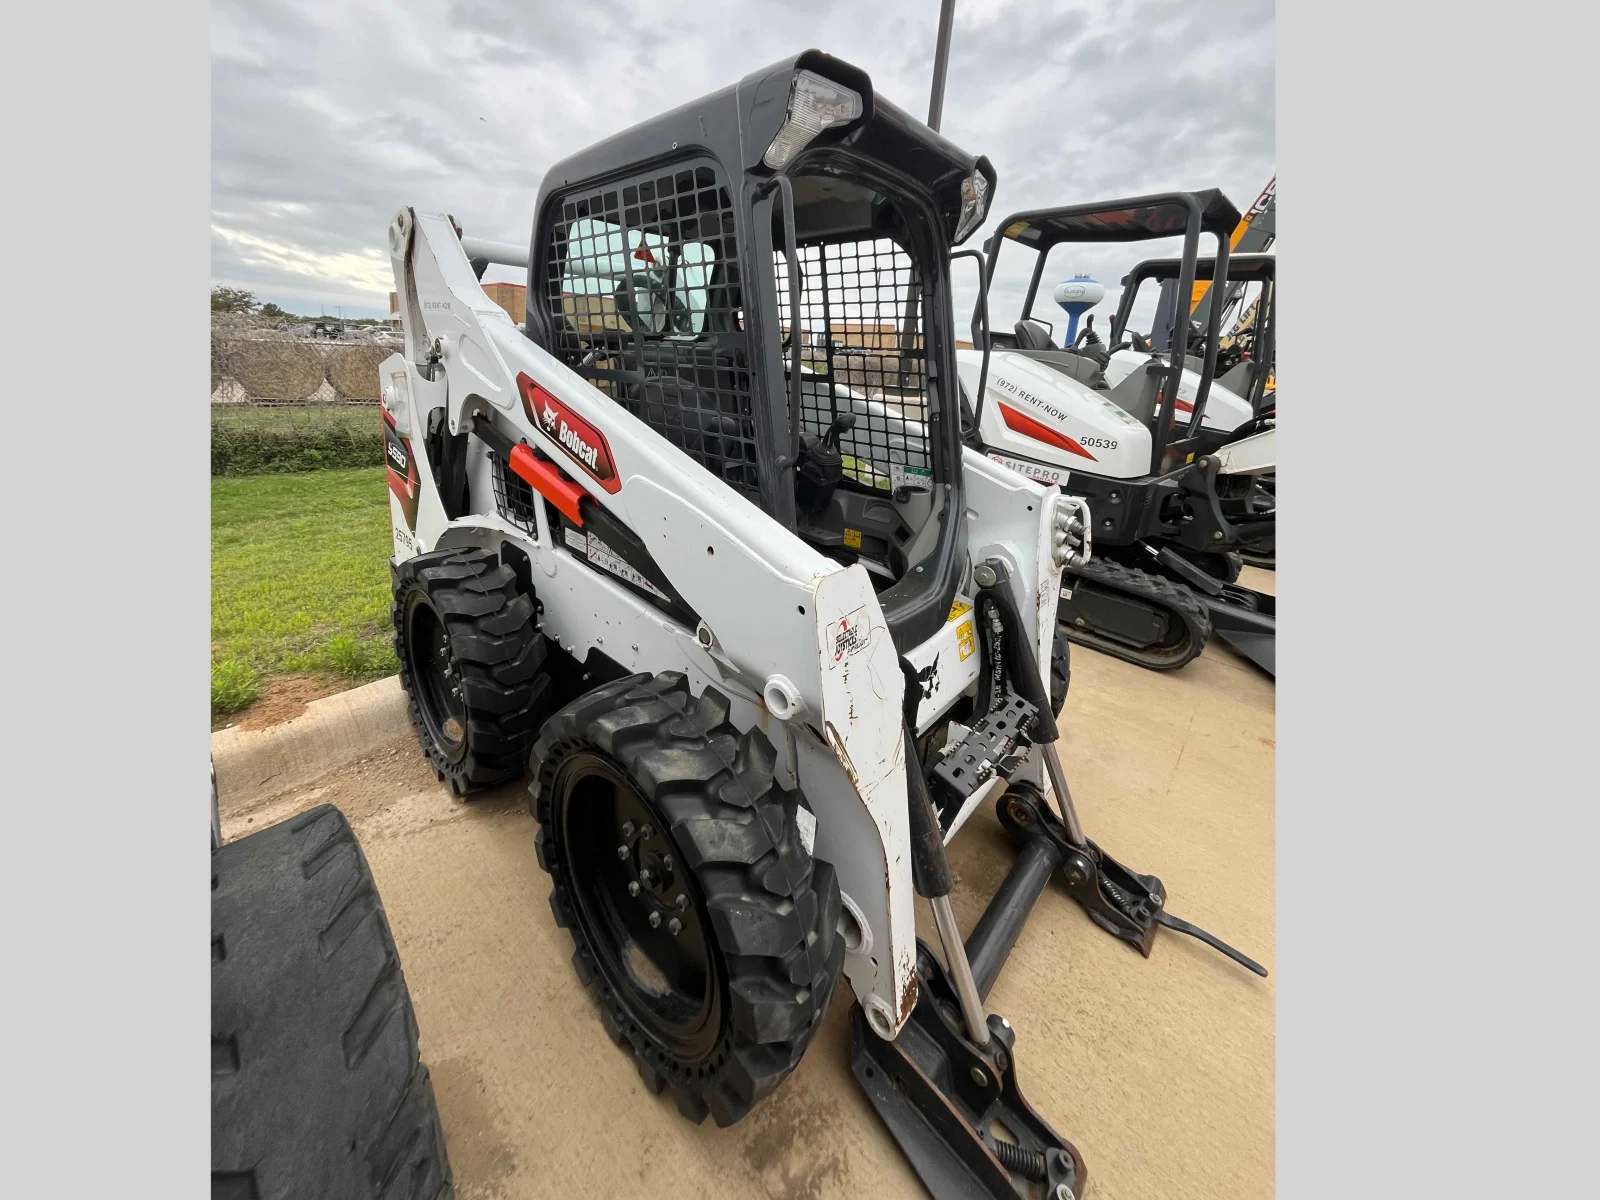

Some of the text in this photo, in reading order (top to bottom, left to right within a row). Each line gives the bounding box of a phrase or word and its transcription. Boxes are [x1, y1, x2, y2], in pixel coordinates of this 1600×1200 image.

[1226, 324, 1240, 341] JLG
[1239, 304, 1257, 324] LIFT
[996, 378, 1068, 421] (972) RENT-NOW
[387, 442, 406, 468] S590
[559, 420, 598, 470] Bobcat
[1080, 436, 1118, 450] 50539
[1005, 461, 1060, 480] SITEPRO
